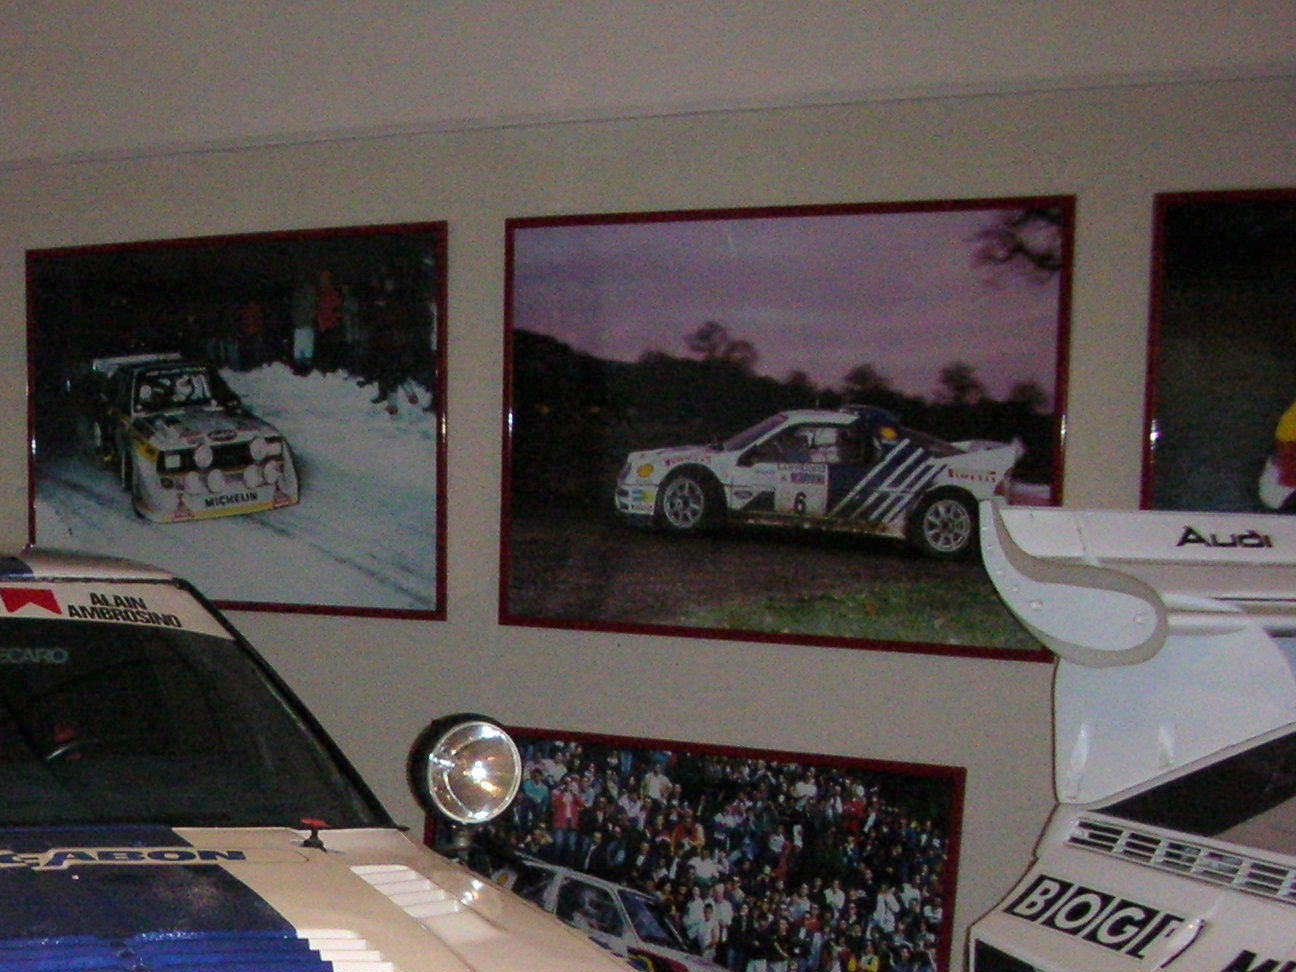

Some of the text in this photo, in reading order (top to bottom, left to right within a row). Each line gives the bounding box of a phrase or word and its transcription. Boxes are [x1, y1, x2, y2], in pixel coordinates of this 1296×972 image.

[205, 492, 258, 508] MICHELIN
[794, 491, 807, 514] 6
[1176, 525, 1273, 549] Audi
[89, 592, 148, 610] ALAIN
[67, 604, 182, 628] AMBROSINO
